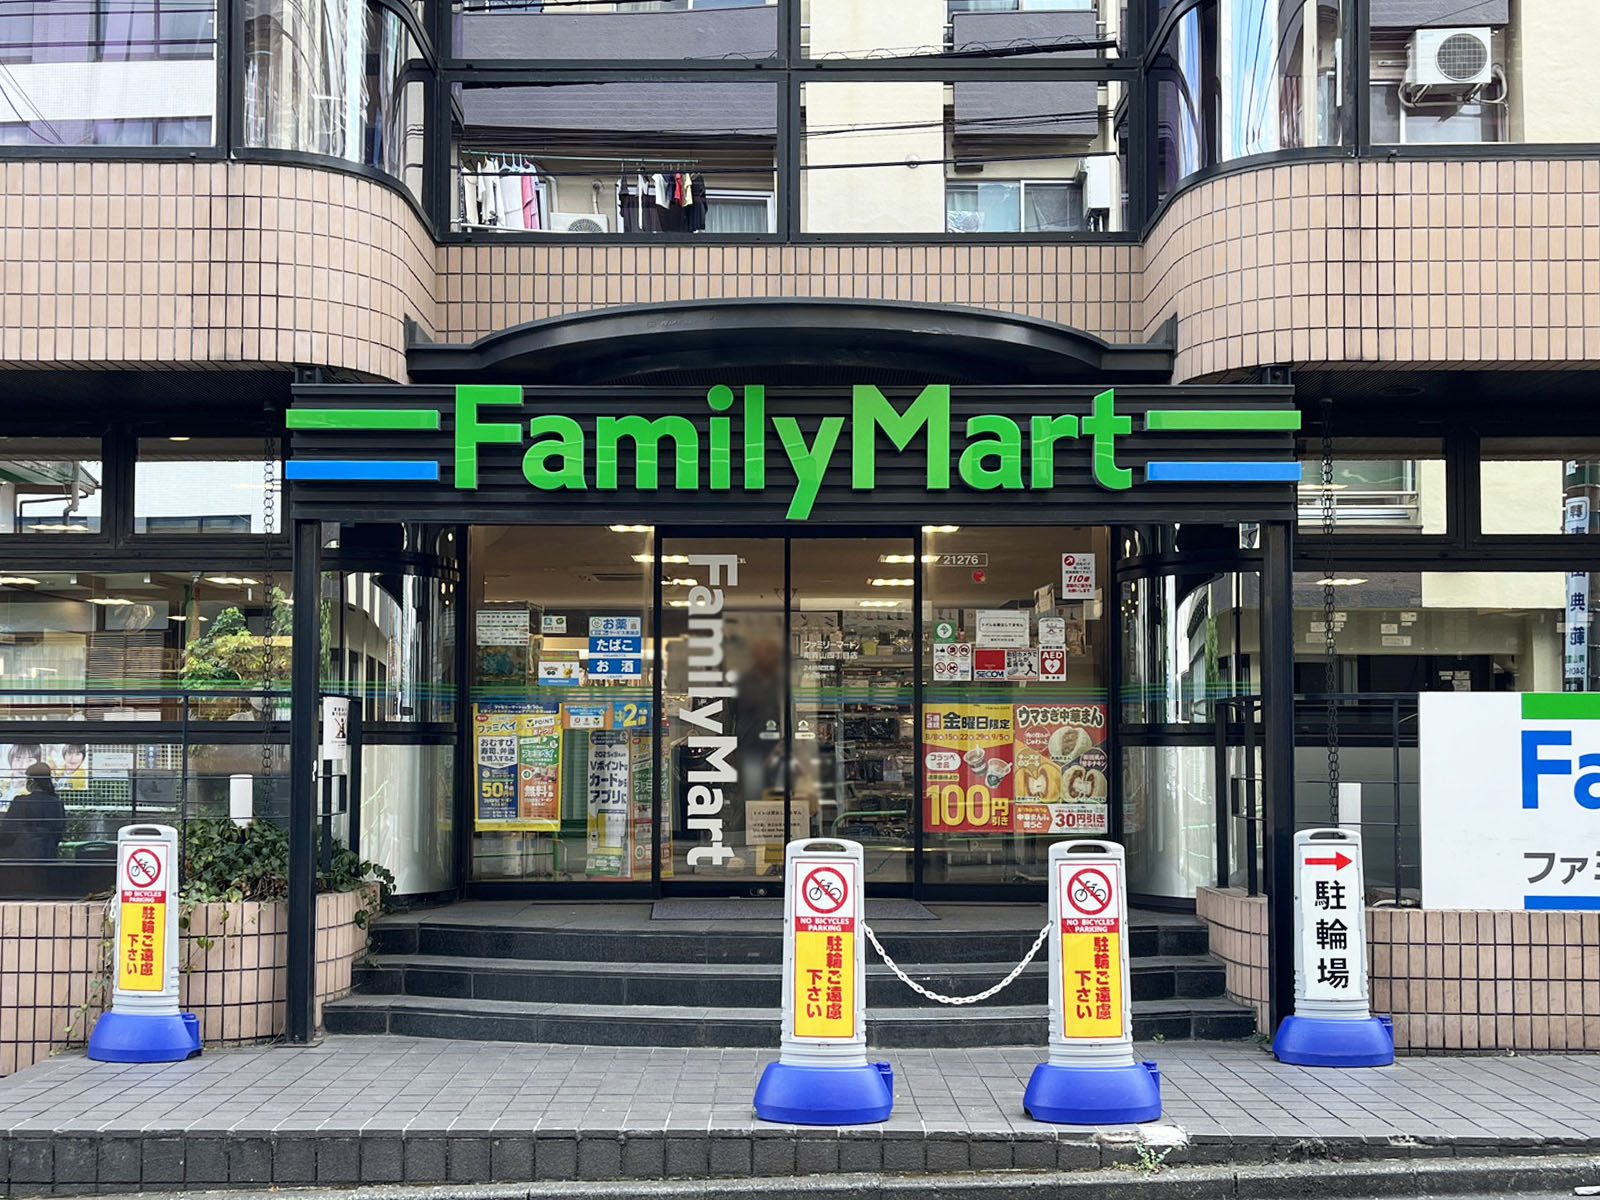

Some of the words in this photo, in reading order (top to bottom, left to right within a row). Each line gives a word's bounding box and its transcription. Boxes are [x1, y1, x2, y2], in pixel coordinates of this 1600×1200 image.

[455, 384, 1132, 519] FamilyMart
[943, 555, 979, 565] 21276
[603, 619, 628, 630] お薬
[597, 639, 634, 651] たばこ
[679, 554, 739, 866] FamilyMart
[943, 711, 1010, 730] 金曜日限定
[1018, 706, 1104, 728] ウマすぎ中華まん
[477, 721, 517, 734] ファミペイ
[1523, 851, 1600, 885] ファ
[800, 917, 812, 925] NO
[814, 917, 850, 925] BICYCLES
[808, 924, 842, 932] PARKING
[1074, 925, 1108, 933] PARKING
[1314, 880, 1350, 989] 駐輪場
[126, 933, 140, 975] 下さい
[140, 906, 156, 976] 駐輪ご遠慮
[806, 968, 823, 1019] 下さい
[825, 935, 843, 1020] 駐輪ご遠慮
[1075, 969, 1092, 1020] 下さい
[1093, 936, 1112, 1020] 駐輪ご遠慮
